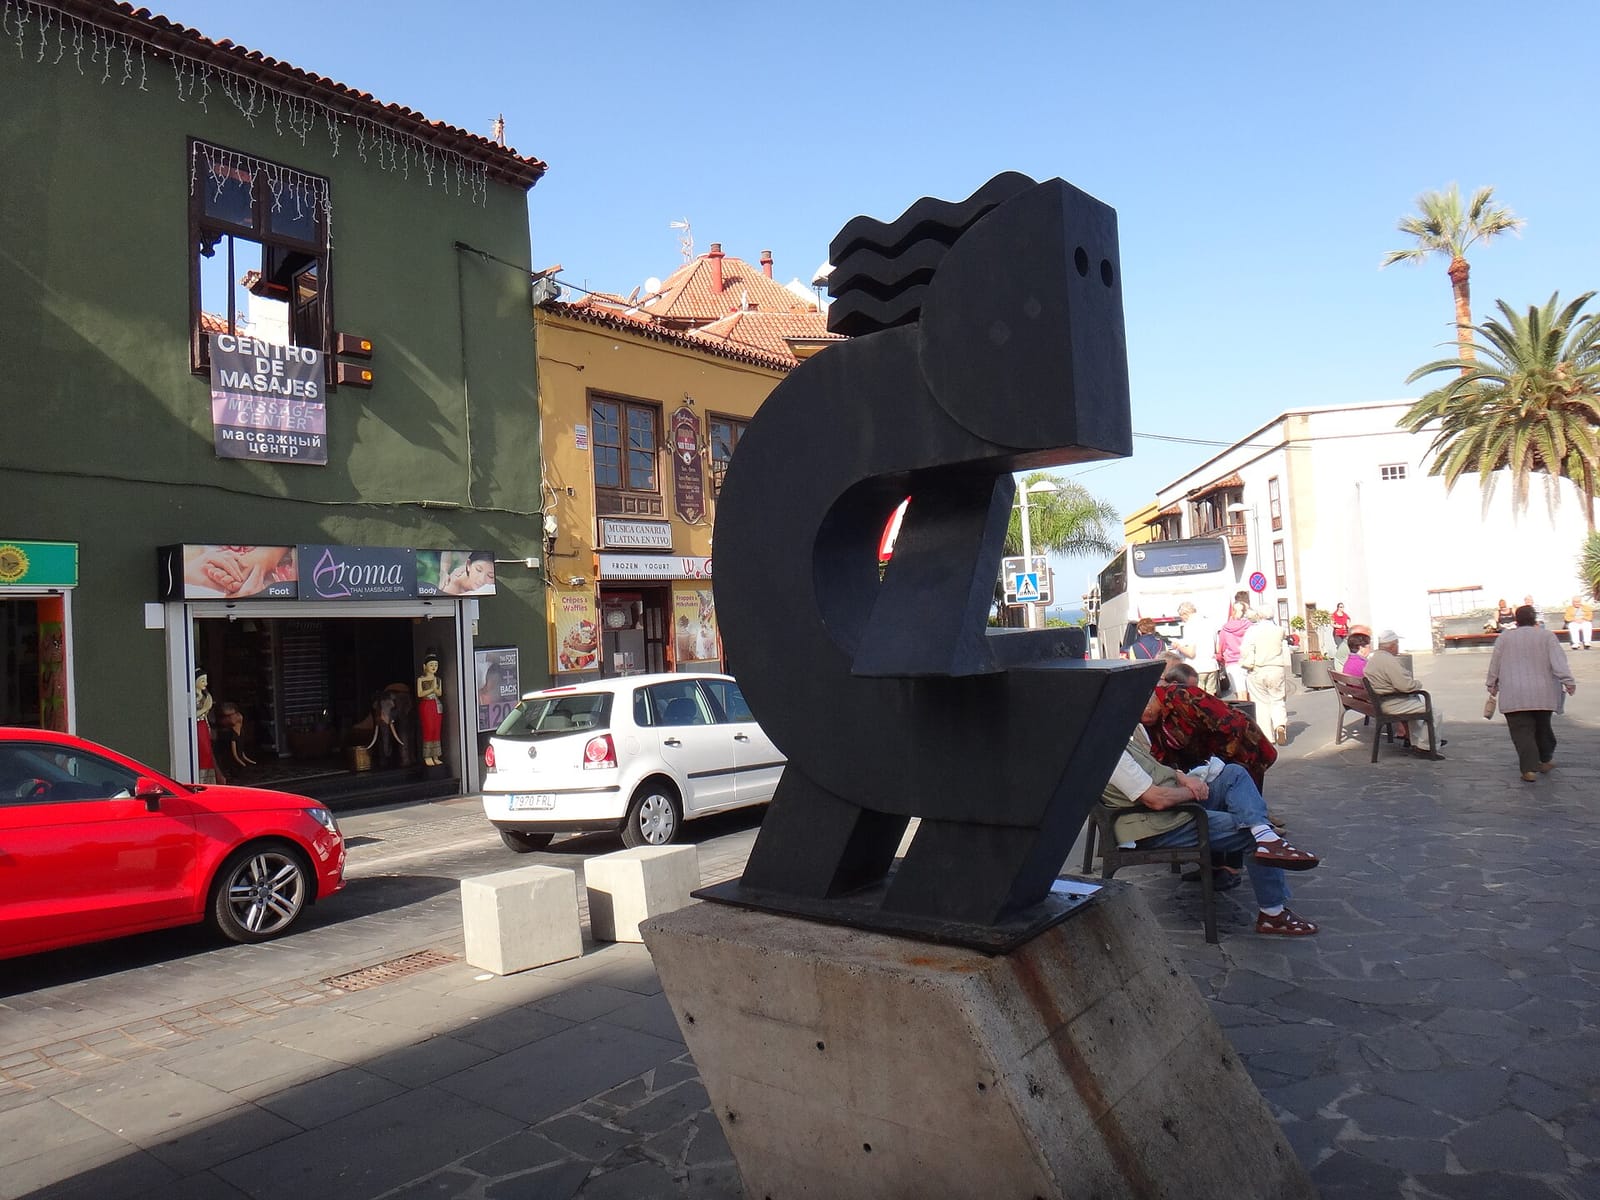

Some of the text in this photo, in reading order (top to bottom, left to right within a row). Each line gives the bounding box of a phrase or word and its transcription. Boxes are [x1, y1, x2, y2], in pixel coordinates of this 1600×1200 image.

[217, 334, 317, 365] CENTRO
[256, 358, 284, 377] DE
[220, 370, 318, 398] MASAJES
[228, 399, 315, 419] MASSAGE
[238, 411, 306, 430] CENTER
[222, 429, 321, 447] массажный
[249, 442, 298, 457] центр
[635, 525, 666, 535] CANARIA
[608, 535, 669, 544] Y LATINA EN VIVO
[313, 548, 403, 590] Aroma
[269, 587, 290, 596] Foot
[418, 586, 437, 596] Body
[500, 685, 517, 695] BACK
